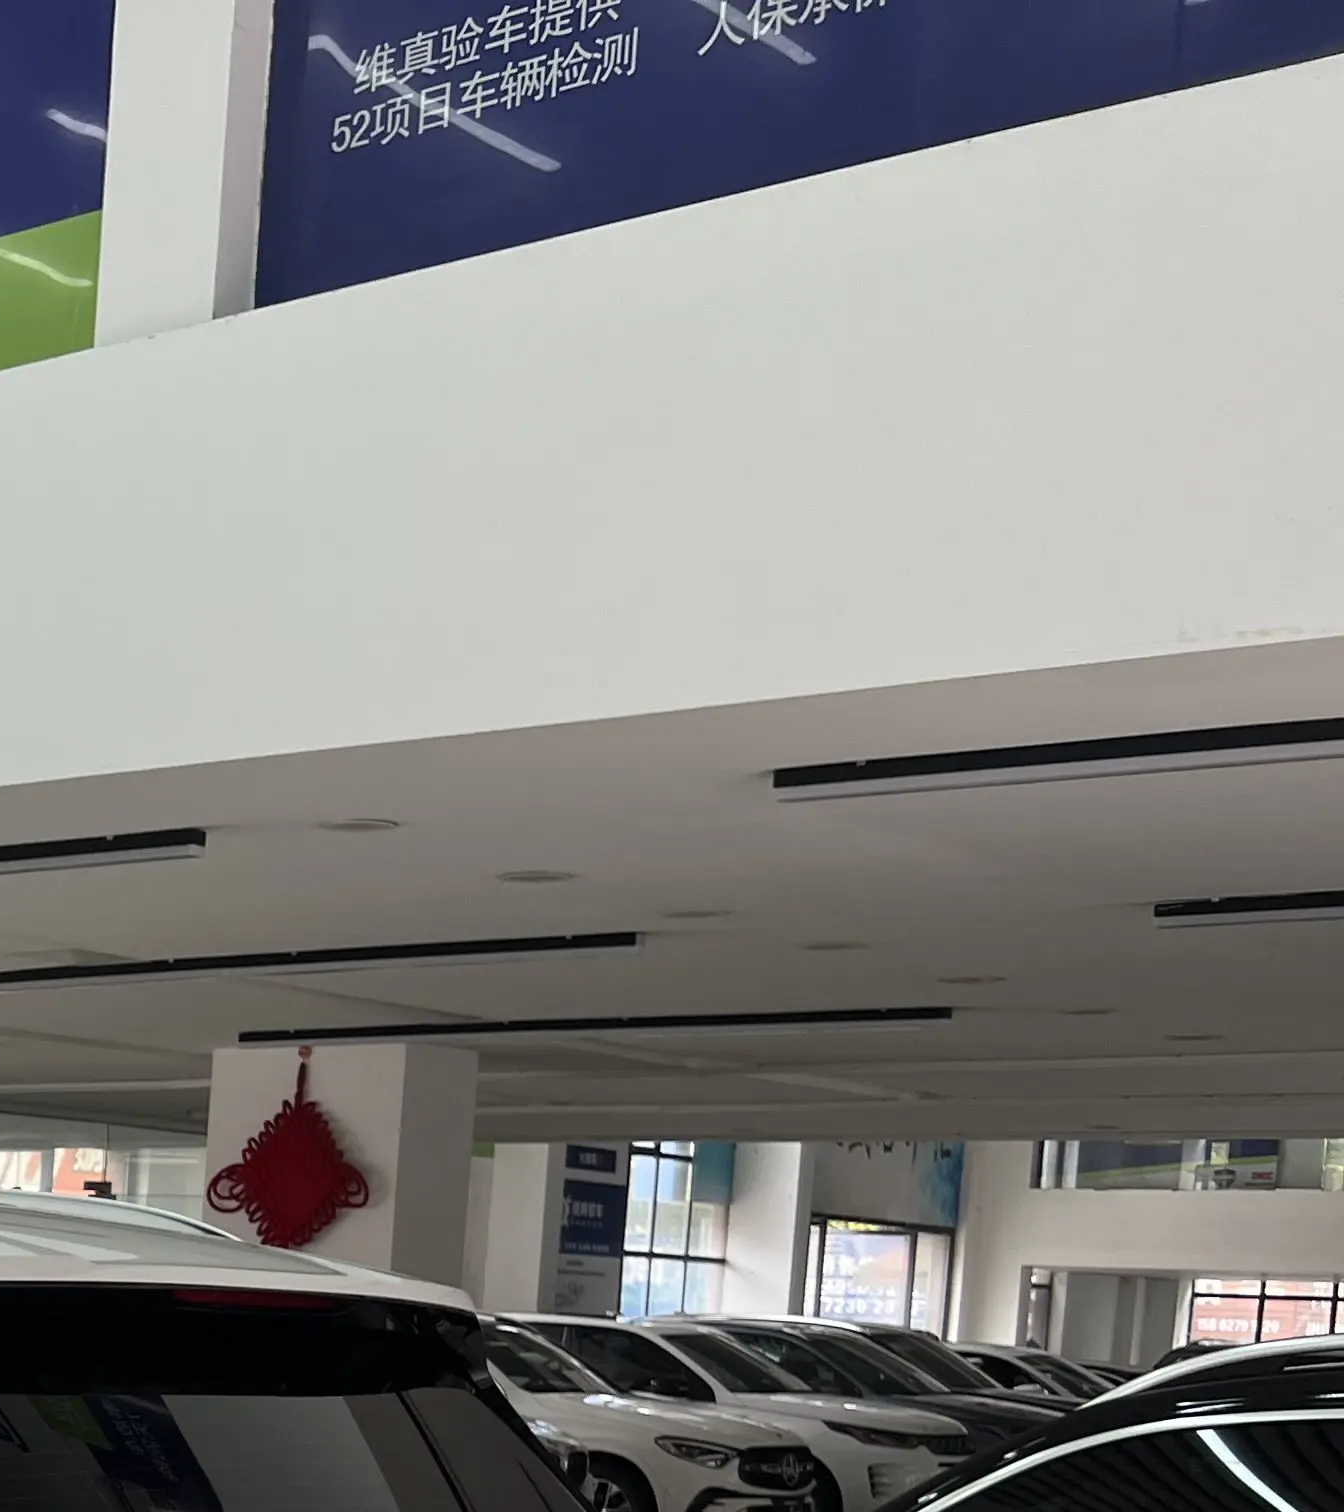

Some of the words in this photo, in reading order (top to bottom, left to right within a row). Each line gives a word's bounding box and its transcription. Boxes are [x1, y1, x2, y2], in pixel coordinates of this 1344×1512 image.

[330, 27, 640, 154] 52项目车辆检测
